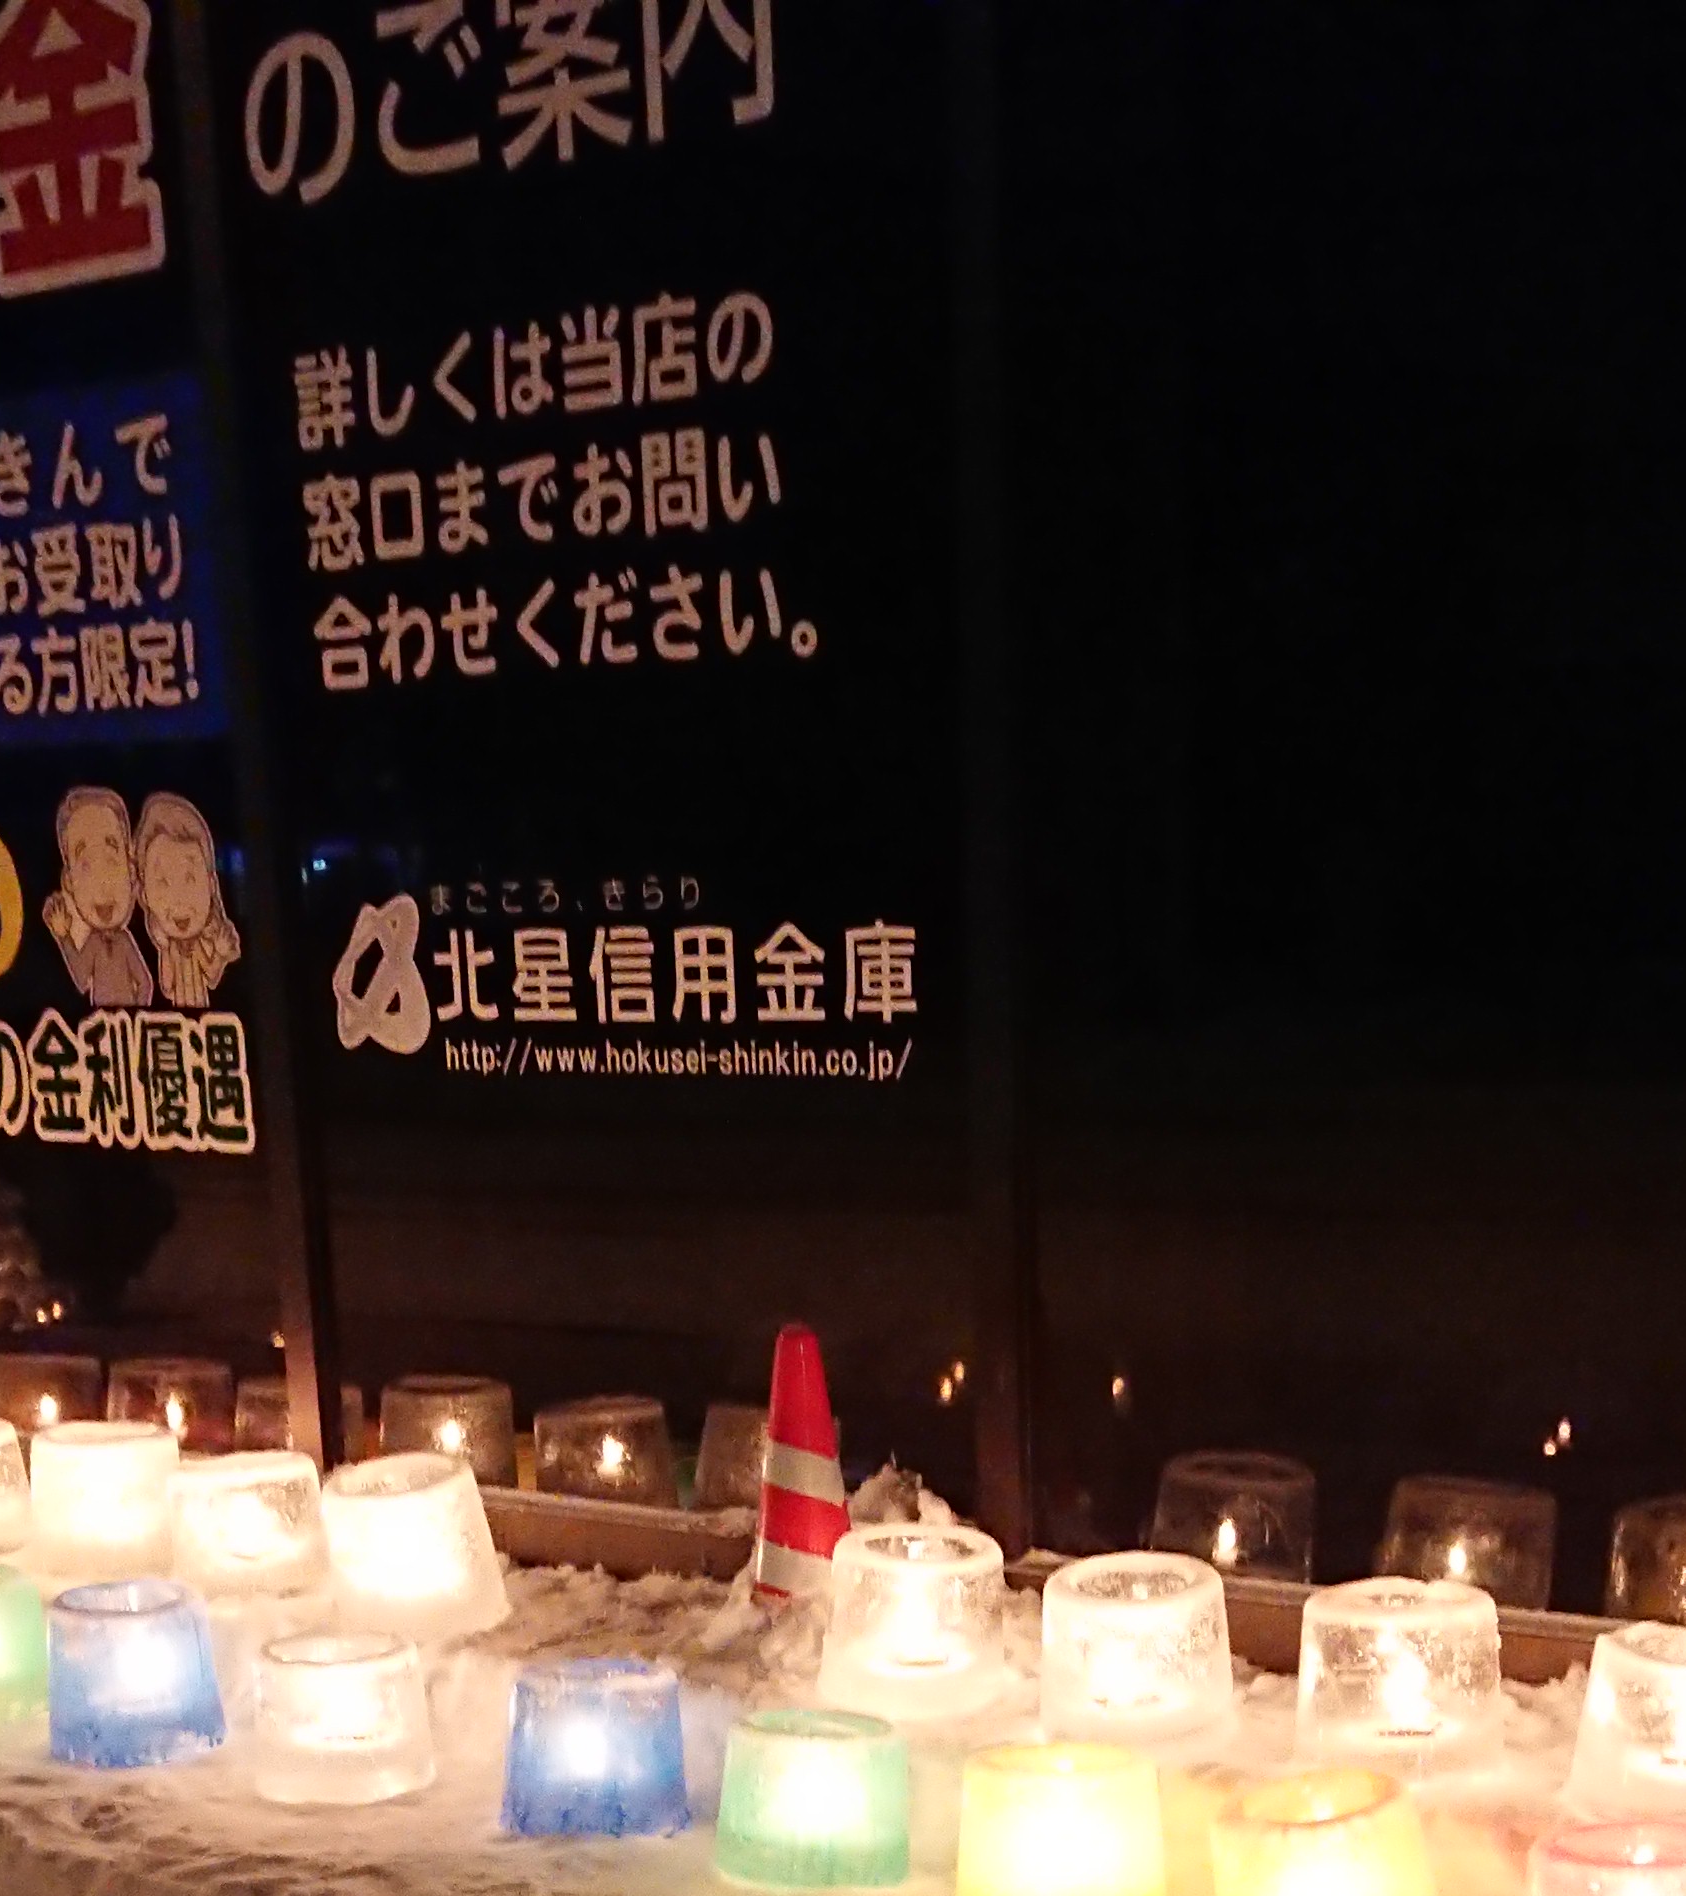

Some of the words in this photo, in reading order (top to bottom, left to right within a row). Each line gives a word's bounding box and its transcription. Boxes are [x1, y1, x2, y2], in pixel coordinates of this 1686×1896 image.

[293, 290, 774, 452] 詳しくは当店の
[301, 427, 782, 573] 窓口までお問い
[314, 563, 819, 692] 合わせください。
[433, 919, 921, 1025] 北星信用金庫
[445, 1036, 913, 1082] http://www.hokusei-shinkin.co.jp/
